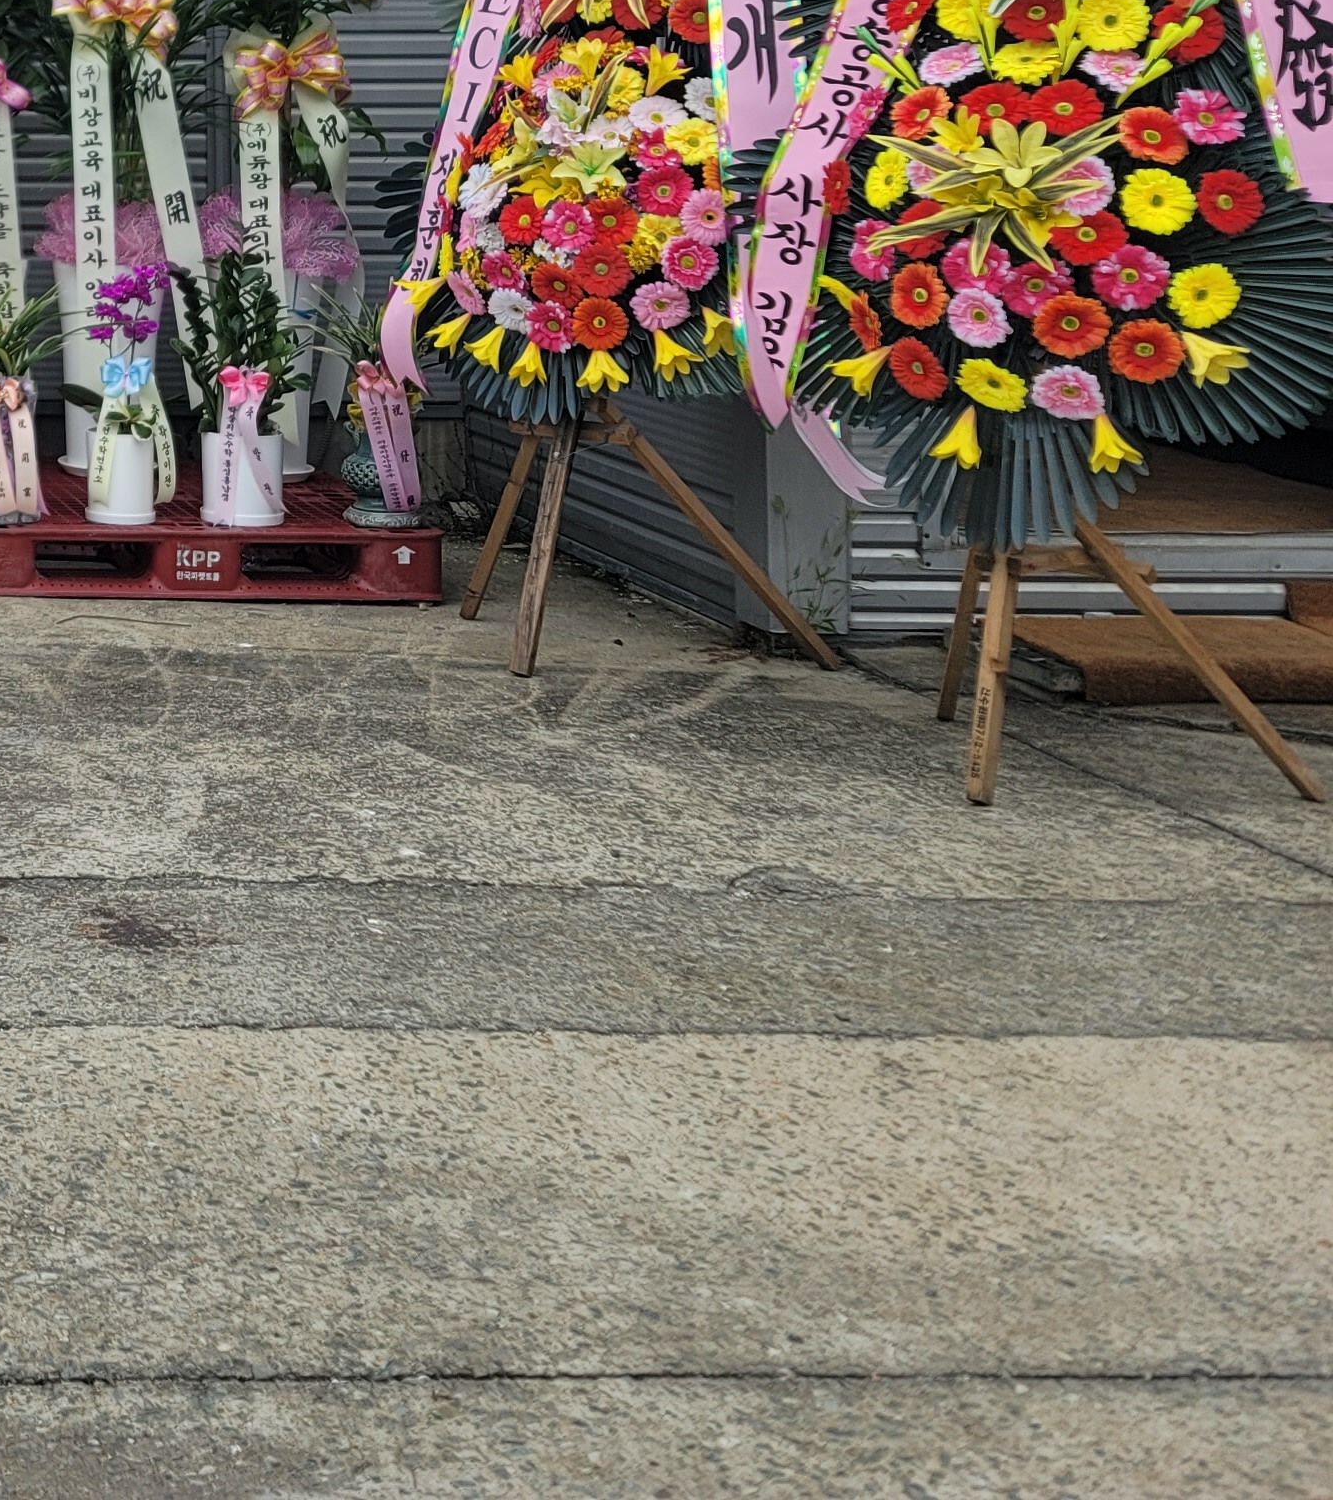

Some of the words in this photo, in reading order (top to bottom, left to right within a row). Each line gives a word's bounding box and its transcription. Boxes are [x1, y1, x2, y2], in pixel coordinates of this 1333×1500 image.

[76, 64, 105, 172] (주)비상교육
[315, 114, 347, 149] 祝
[246, 122, 273, 190] (주)에듀왕
[80, 180, 108, 269] 대표이사
[246, 197, 275, 266] 대표이사
[767, 174, 823, 266] 사장
[176, 549, 221, 568] KPP
